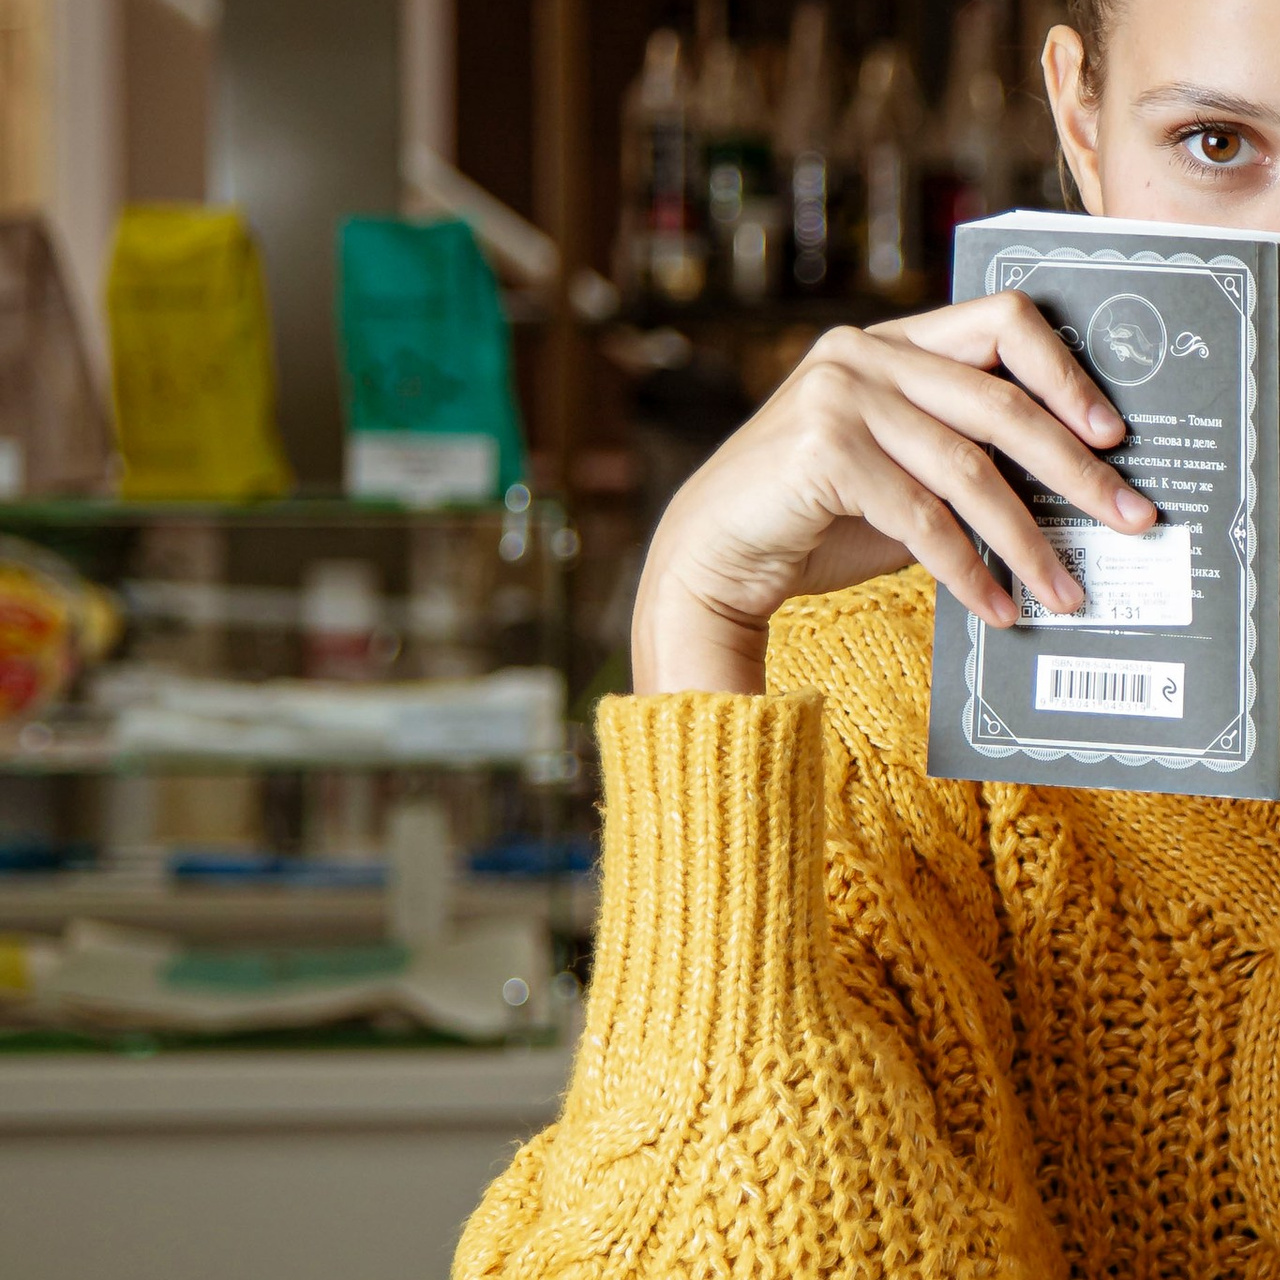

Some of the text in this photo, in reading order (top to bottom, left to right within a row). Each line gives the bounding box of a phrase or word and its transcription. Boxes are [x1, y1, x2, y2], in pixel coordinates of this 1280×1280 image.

[1128, 413, 1177, 426] сыщиков
[1188, 414, 1223, 428] Томми
[1153, 437, 1182, 447] снова
[1184, 439, 1191, 447] в
[1192, 439, 1218, 449] деле.
[1103, 455, 1227, 471] асса веселых и захваты-
[1161, 477, 1170, 489] К
[1171, 480, 1197, 491] тому
[1198, 482, 1214, 492] же
[1033, 495, 1073, 505] кажда
[1153, 500, 1209, 513] оничного
[1110, 606, 1141, 620] 1-31
